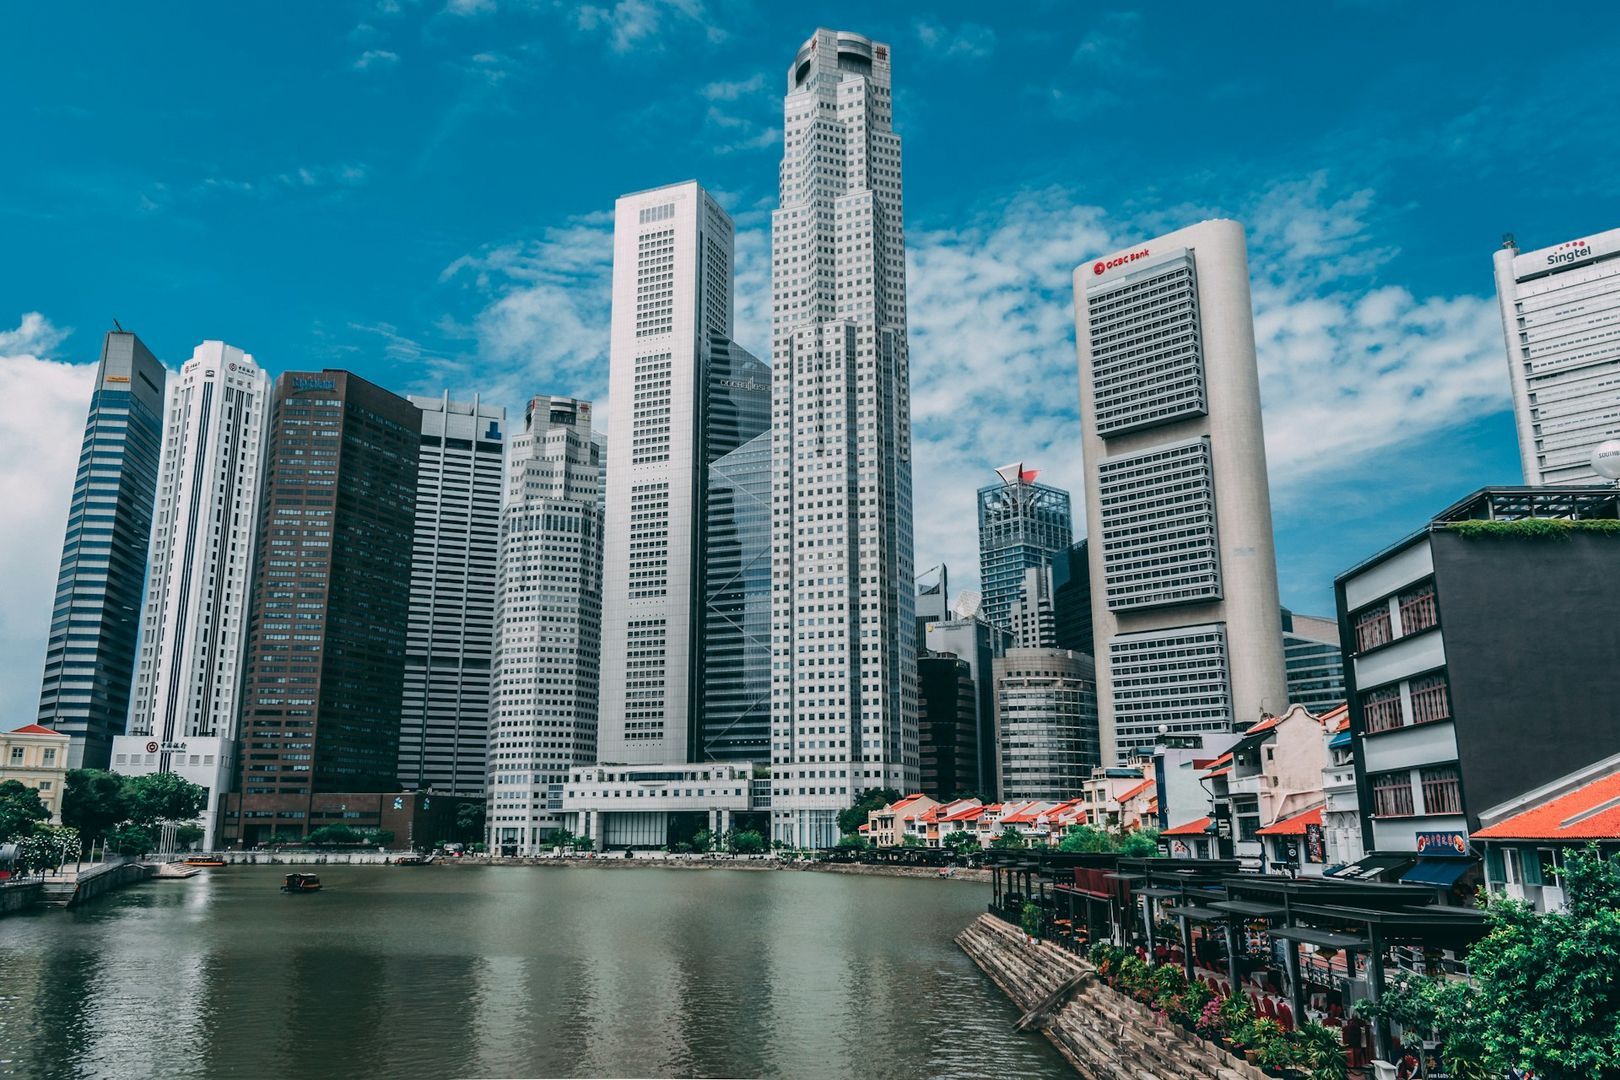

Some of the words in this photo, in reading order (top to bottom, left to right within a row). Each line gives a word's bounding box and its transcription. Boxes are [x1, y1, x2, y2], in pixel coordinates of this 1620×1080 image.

[1106, 256, 1129, 270] OCBC
[1130, 248, 1150, 262] Bank
[1547, 246, 1592, 265] Singtel
